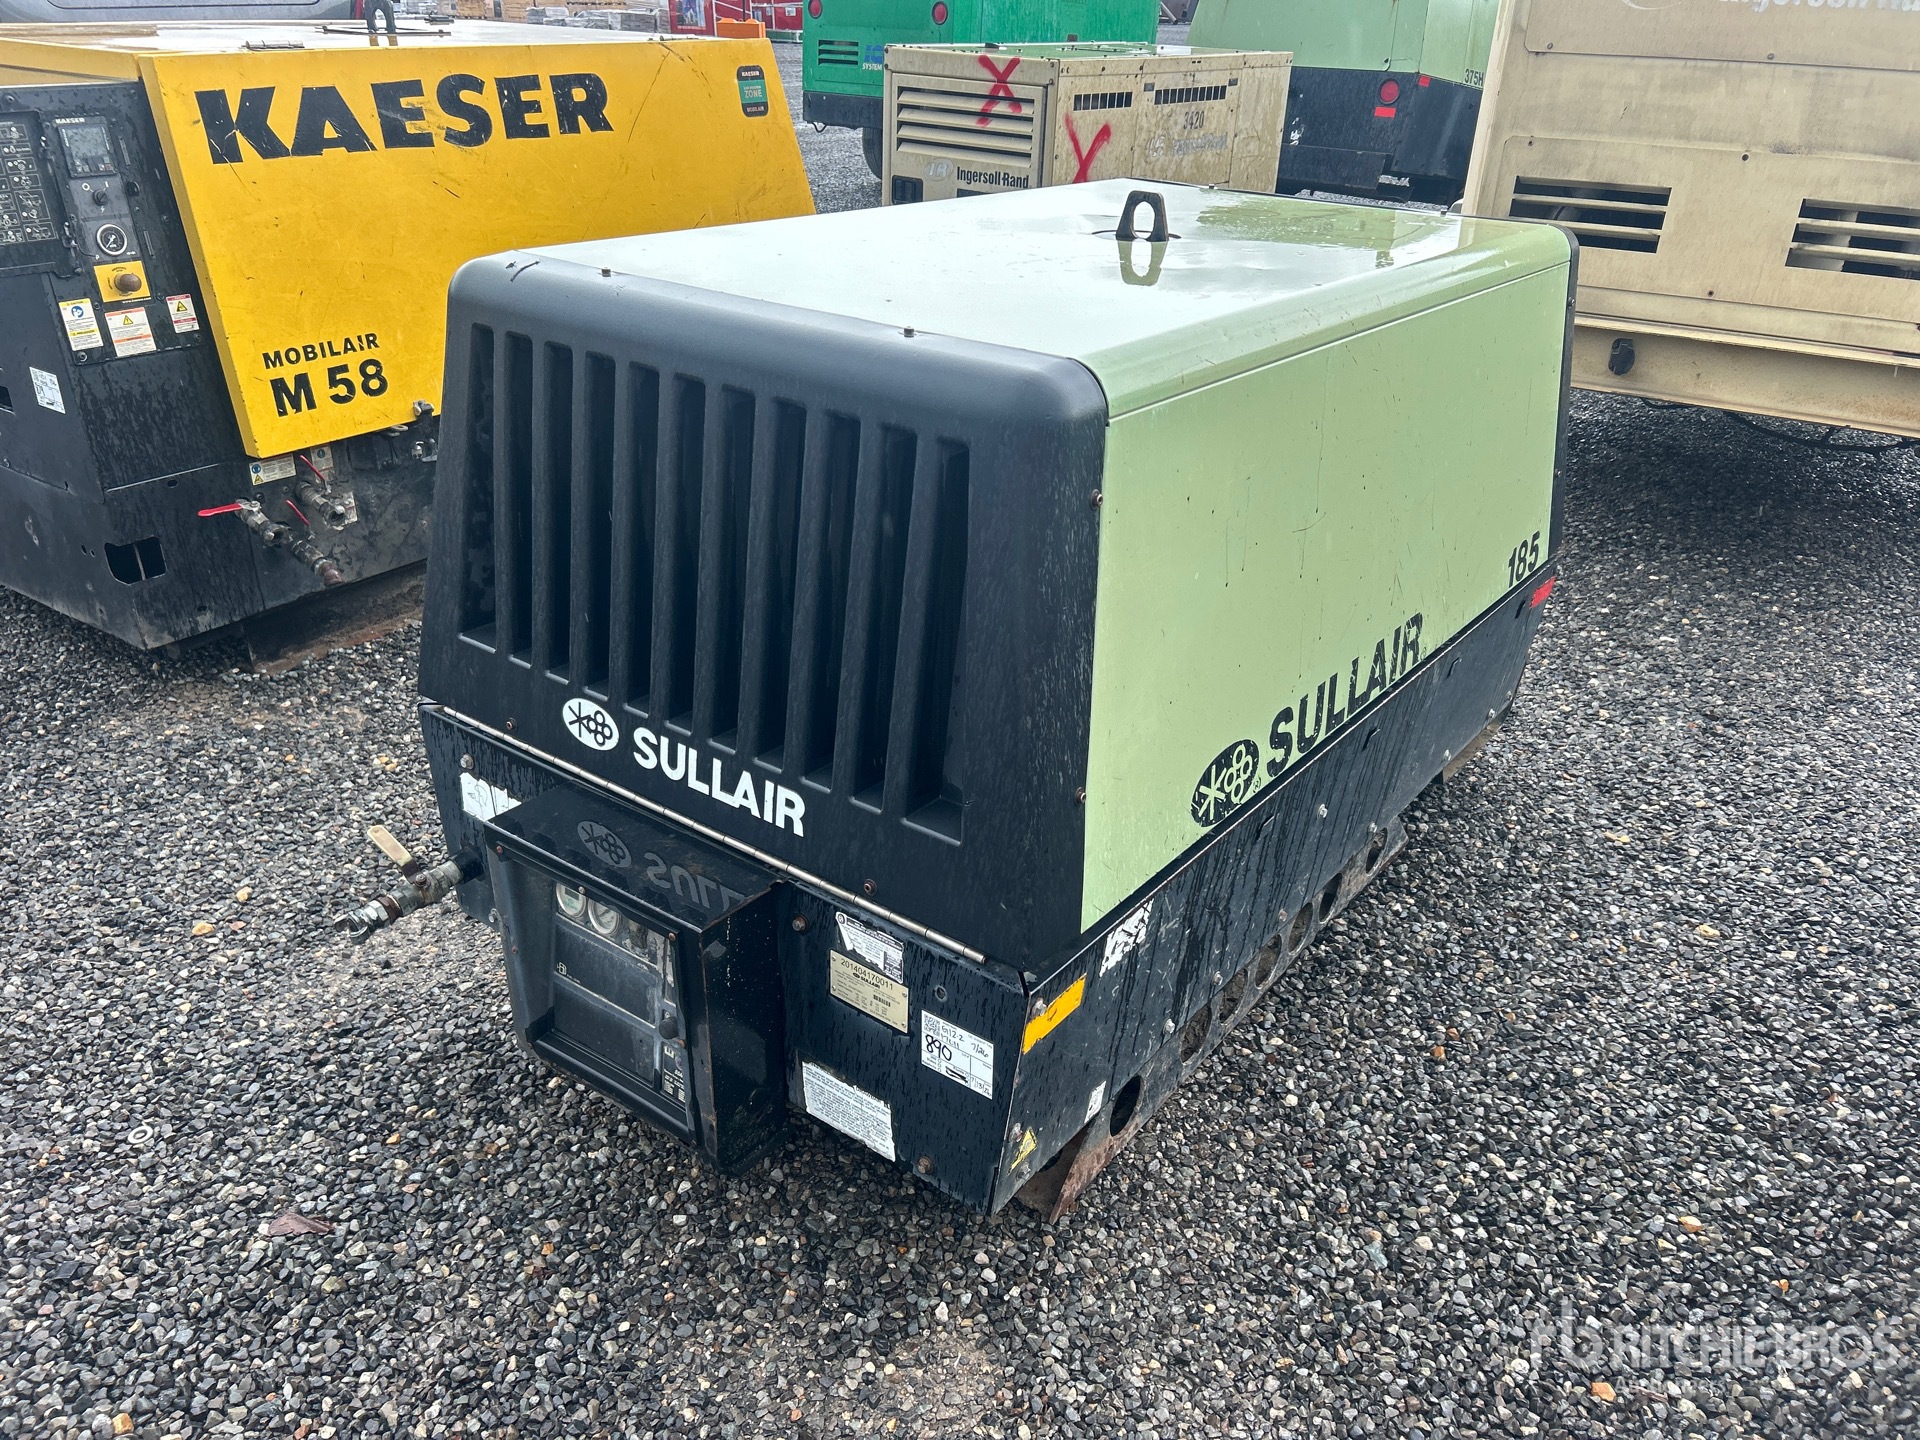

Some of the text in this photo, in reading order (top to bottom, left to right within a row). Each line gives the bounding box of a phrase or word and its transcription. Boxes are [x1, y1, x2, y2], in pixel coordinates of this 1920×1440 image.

[744, 90, 763, 98] ZONE
[1464, 68, 1485, 87] 375H
[194, 73, 614, 164] KAESER
[1183, 110, 1205, 130] 3420
[262, 333, 380, 370] MOBILAIR
[270, 358, 389, 417] M 58
[1508, 531, 1541, 588] 185
[1267, 612, 1424, 777] SULLAIR
[633, 727, 806, 838] SULLAIR
[841, 958, 893, 991] 201404170011
[925, 1034, 952, 1062] 890
